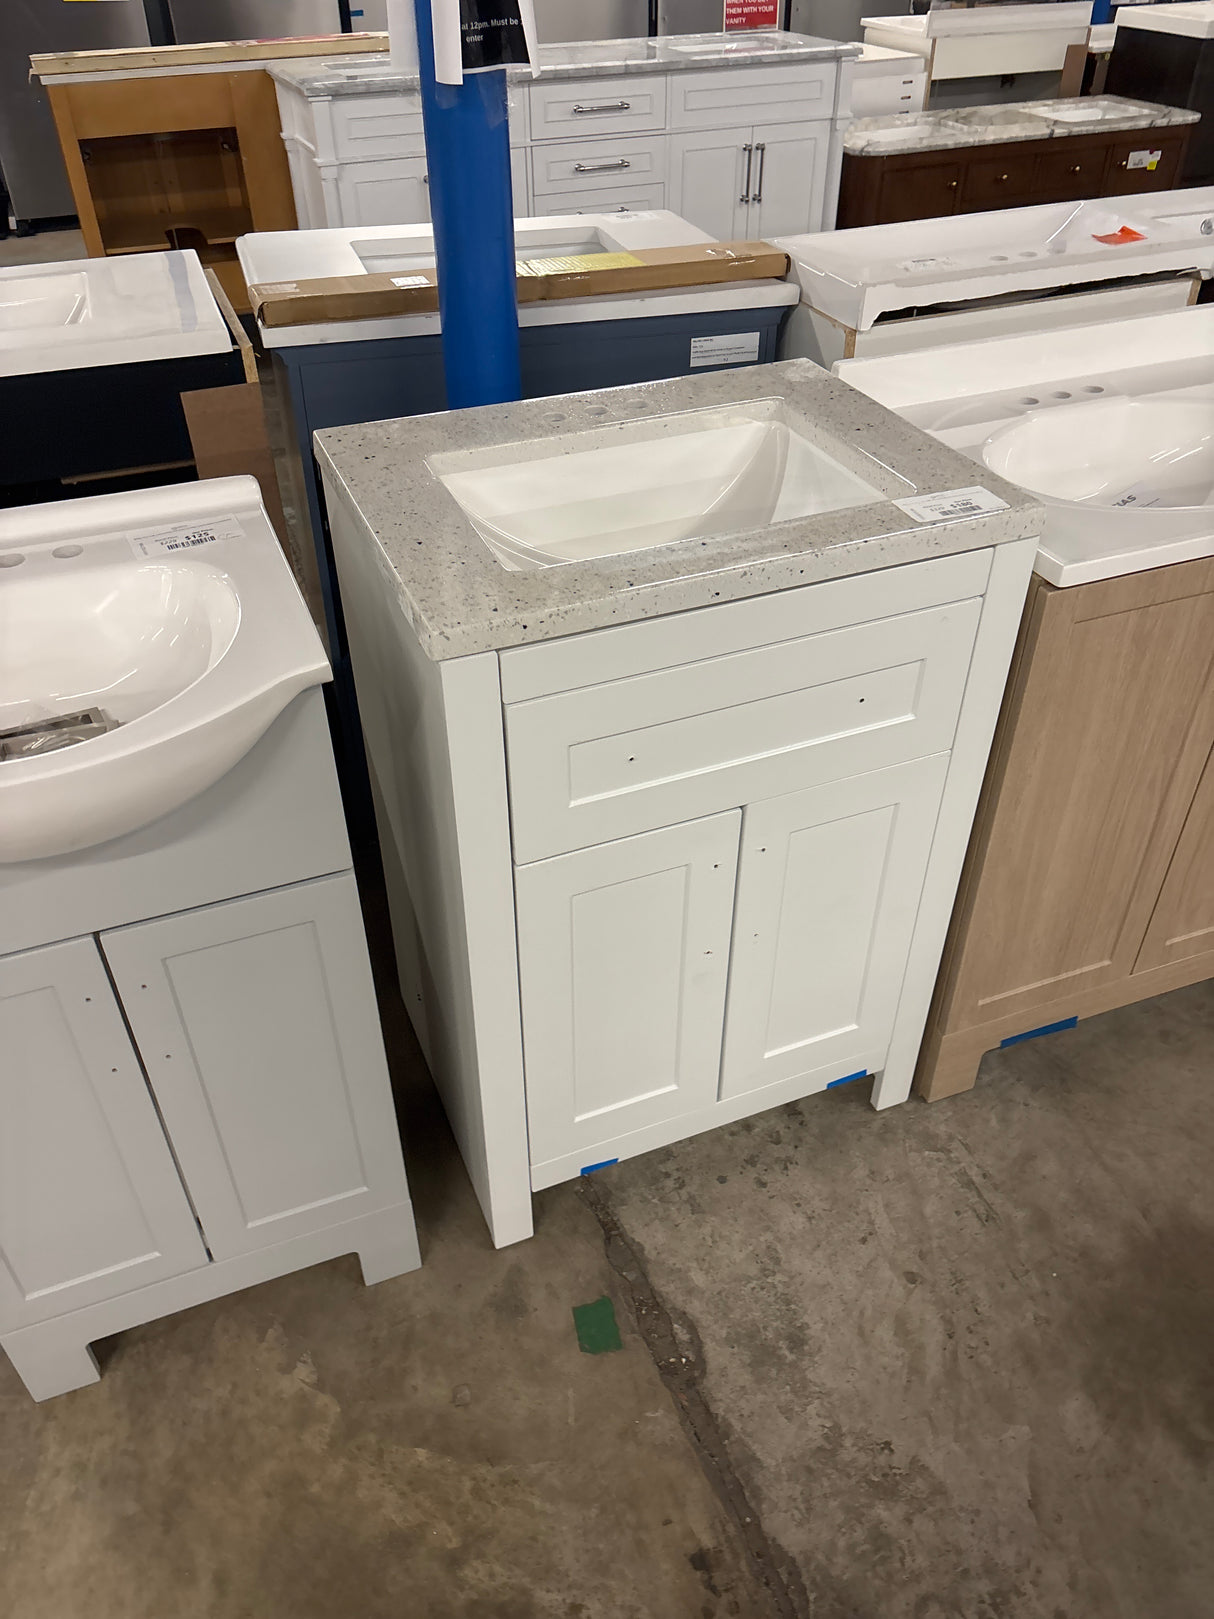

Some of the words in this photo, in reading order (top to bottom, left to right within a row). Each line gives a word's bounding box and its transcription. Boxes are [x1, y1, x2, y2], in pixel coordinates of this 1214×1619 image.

[490, 18, 508, 27] Must
[509, 17, 519, 25] be
[466, 34, 484, 43] enter
